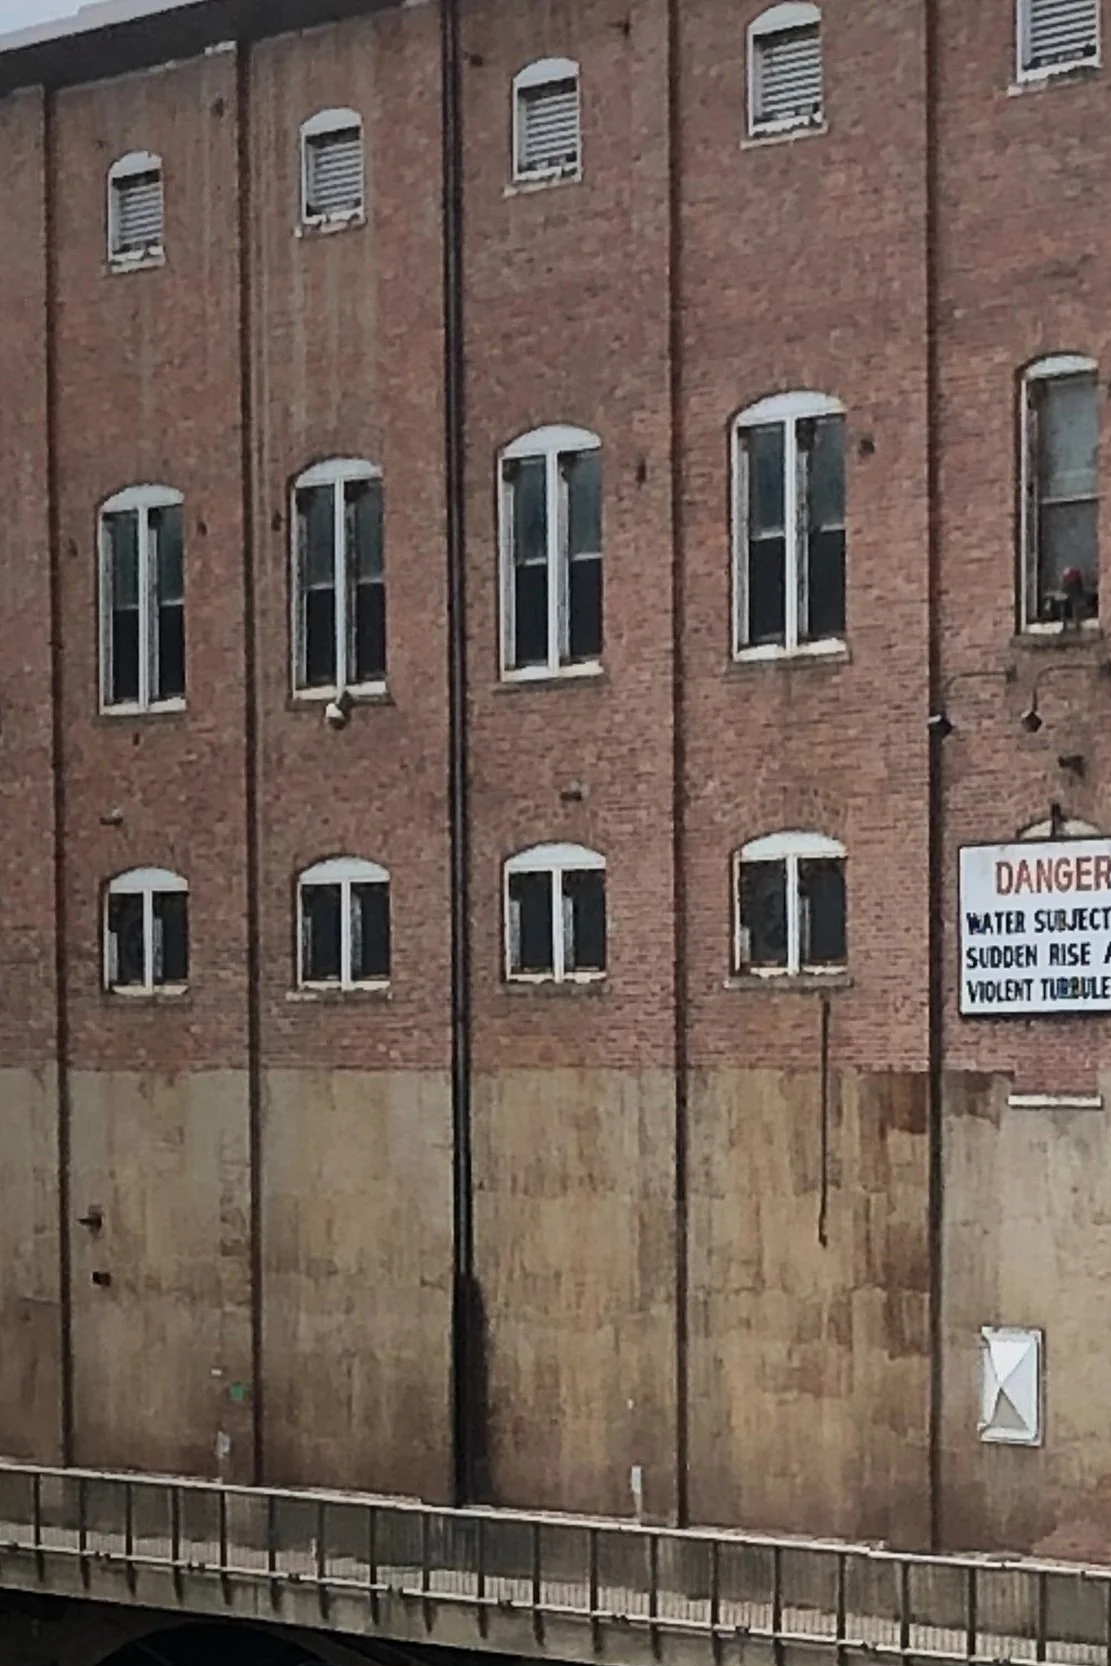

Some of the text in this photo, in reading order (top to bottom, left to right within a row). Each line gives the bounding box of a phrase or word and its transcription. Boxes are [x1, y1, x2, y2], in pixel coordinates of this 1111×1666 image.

[966, 910, 1025, 935] WATER
[1034, 907, 1111, 933] SUBJECT
[966, 944, 1037, 969] SUDDEN
[1050, 942, 1090, 966] RISE
[967, 979, 1033, 1003] VIOLENT
